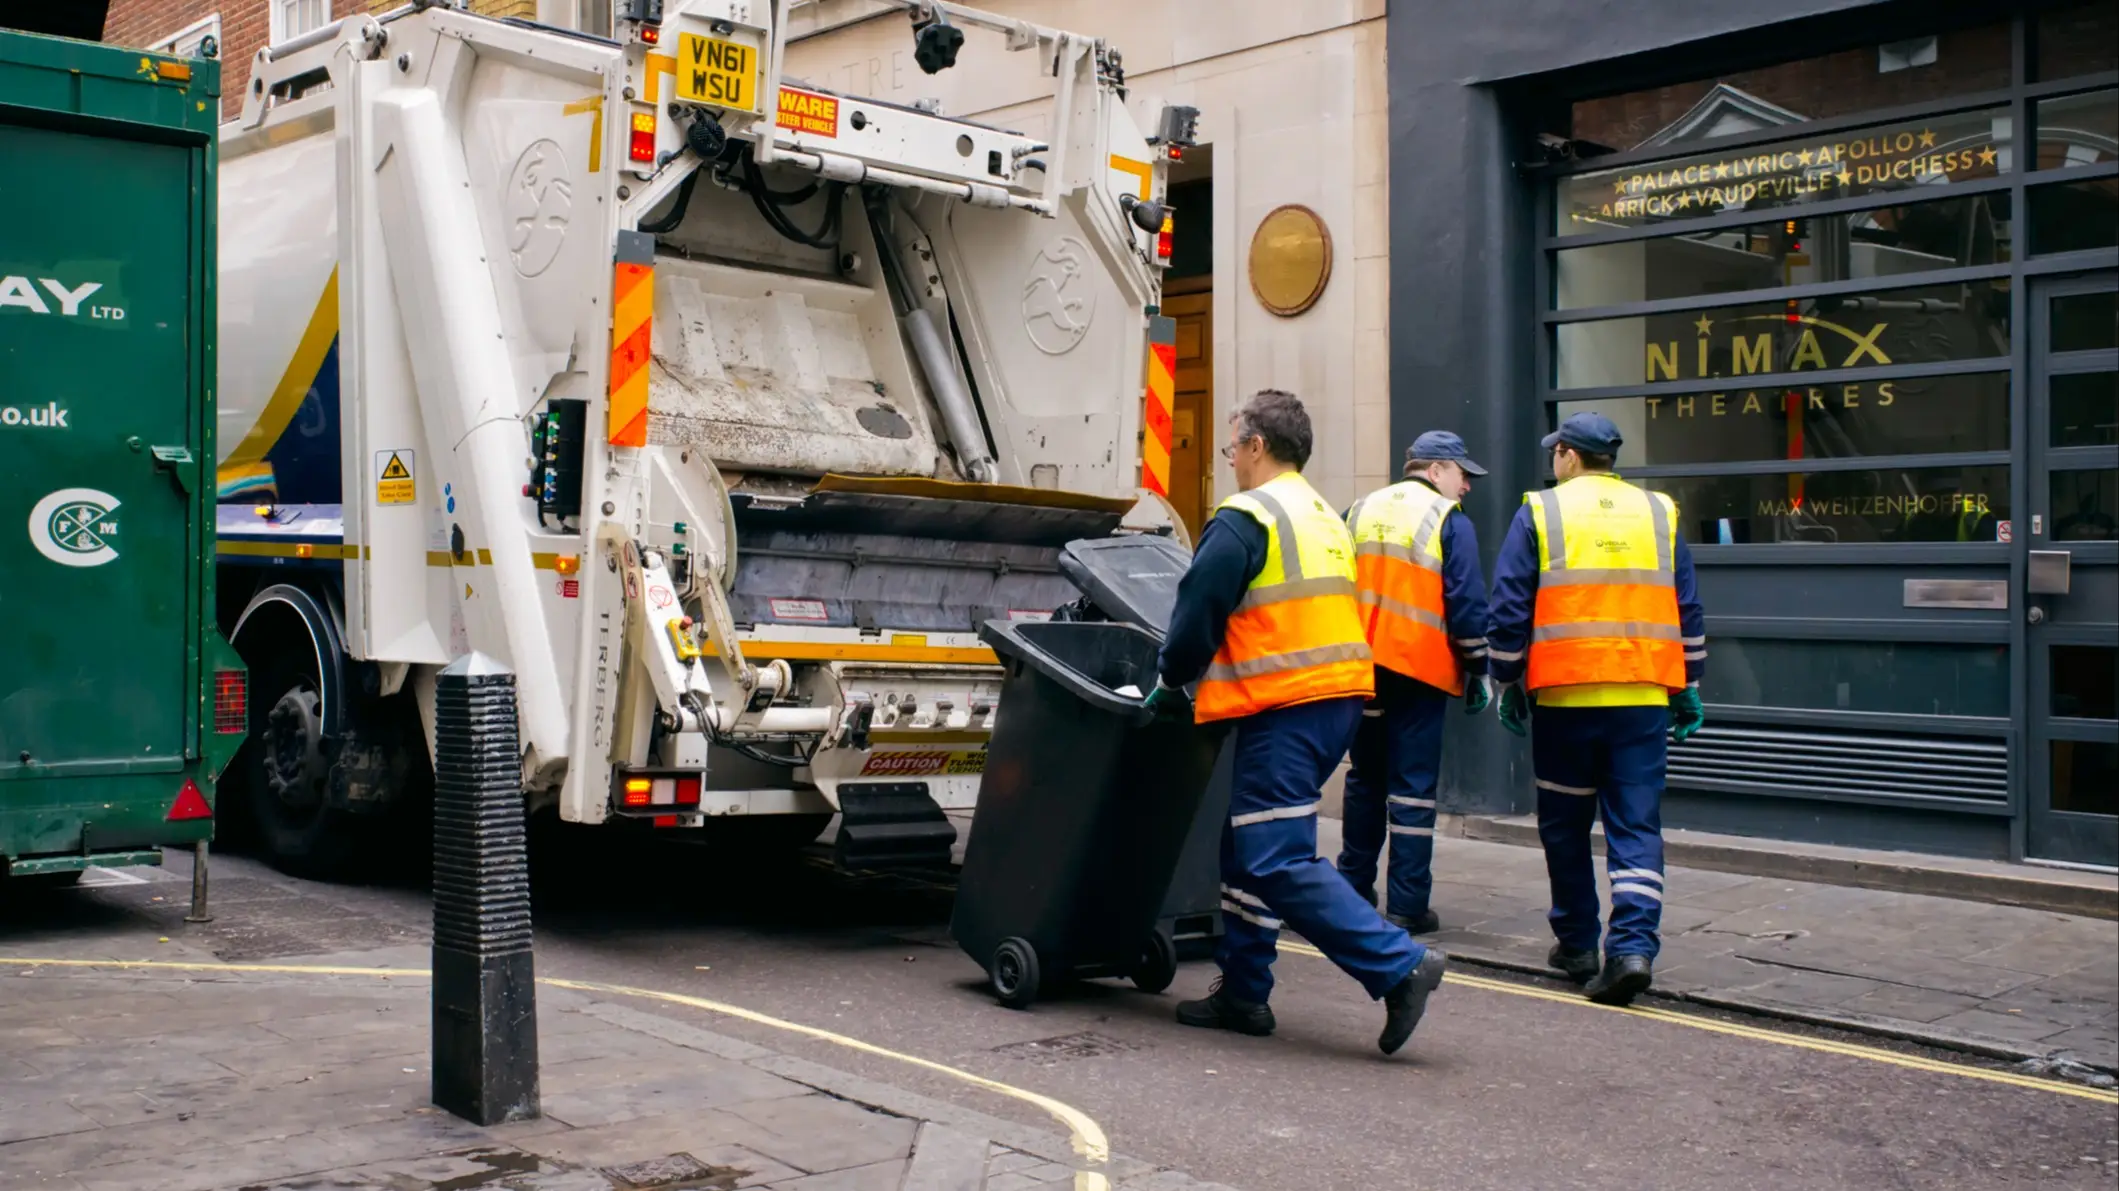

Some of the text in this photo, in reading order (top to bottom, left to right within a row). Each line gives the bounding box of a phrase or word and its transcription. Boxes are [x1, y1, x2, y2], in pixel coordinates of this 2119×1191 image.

[691, 37, 746, 74] VN61
[692, 69, 741, 103] WSU
[1631, 132, 1914, 193] PALACE LYRIC APOLLO
[1696, 171, 1832, 206] VAUDEVILLE
[1857, 150, 1974, 185] DUCHESS
[91, 305, 125, 320] LTD
[1646, 320, 1893, 382] NIMAX
[0, 401, 68, 427] o.uk
[1757, 493, 1990, 517] MAX WEITZENHOFFER
[594, 612, 609, 747] TERBERG
[869, 758, 942, 770] CAUTION
